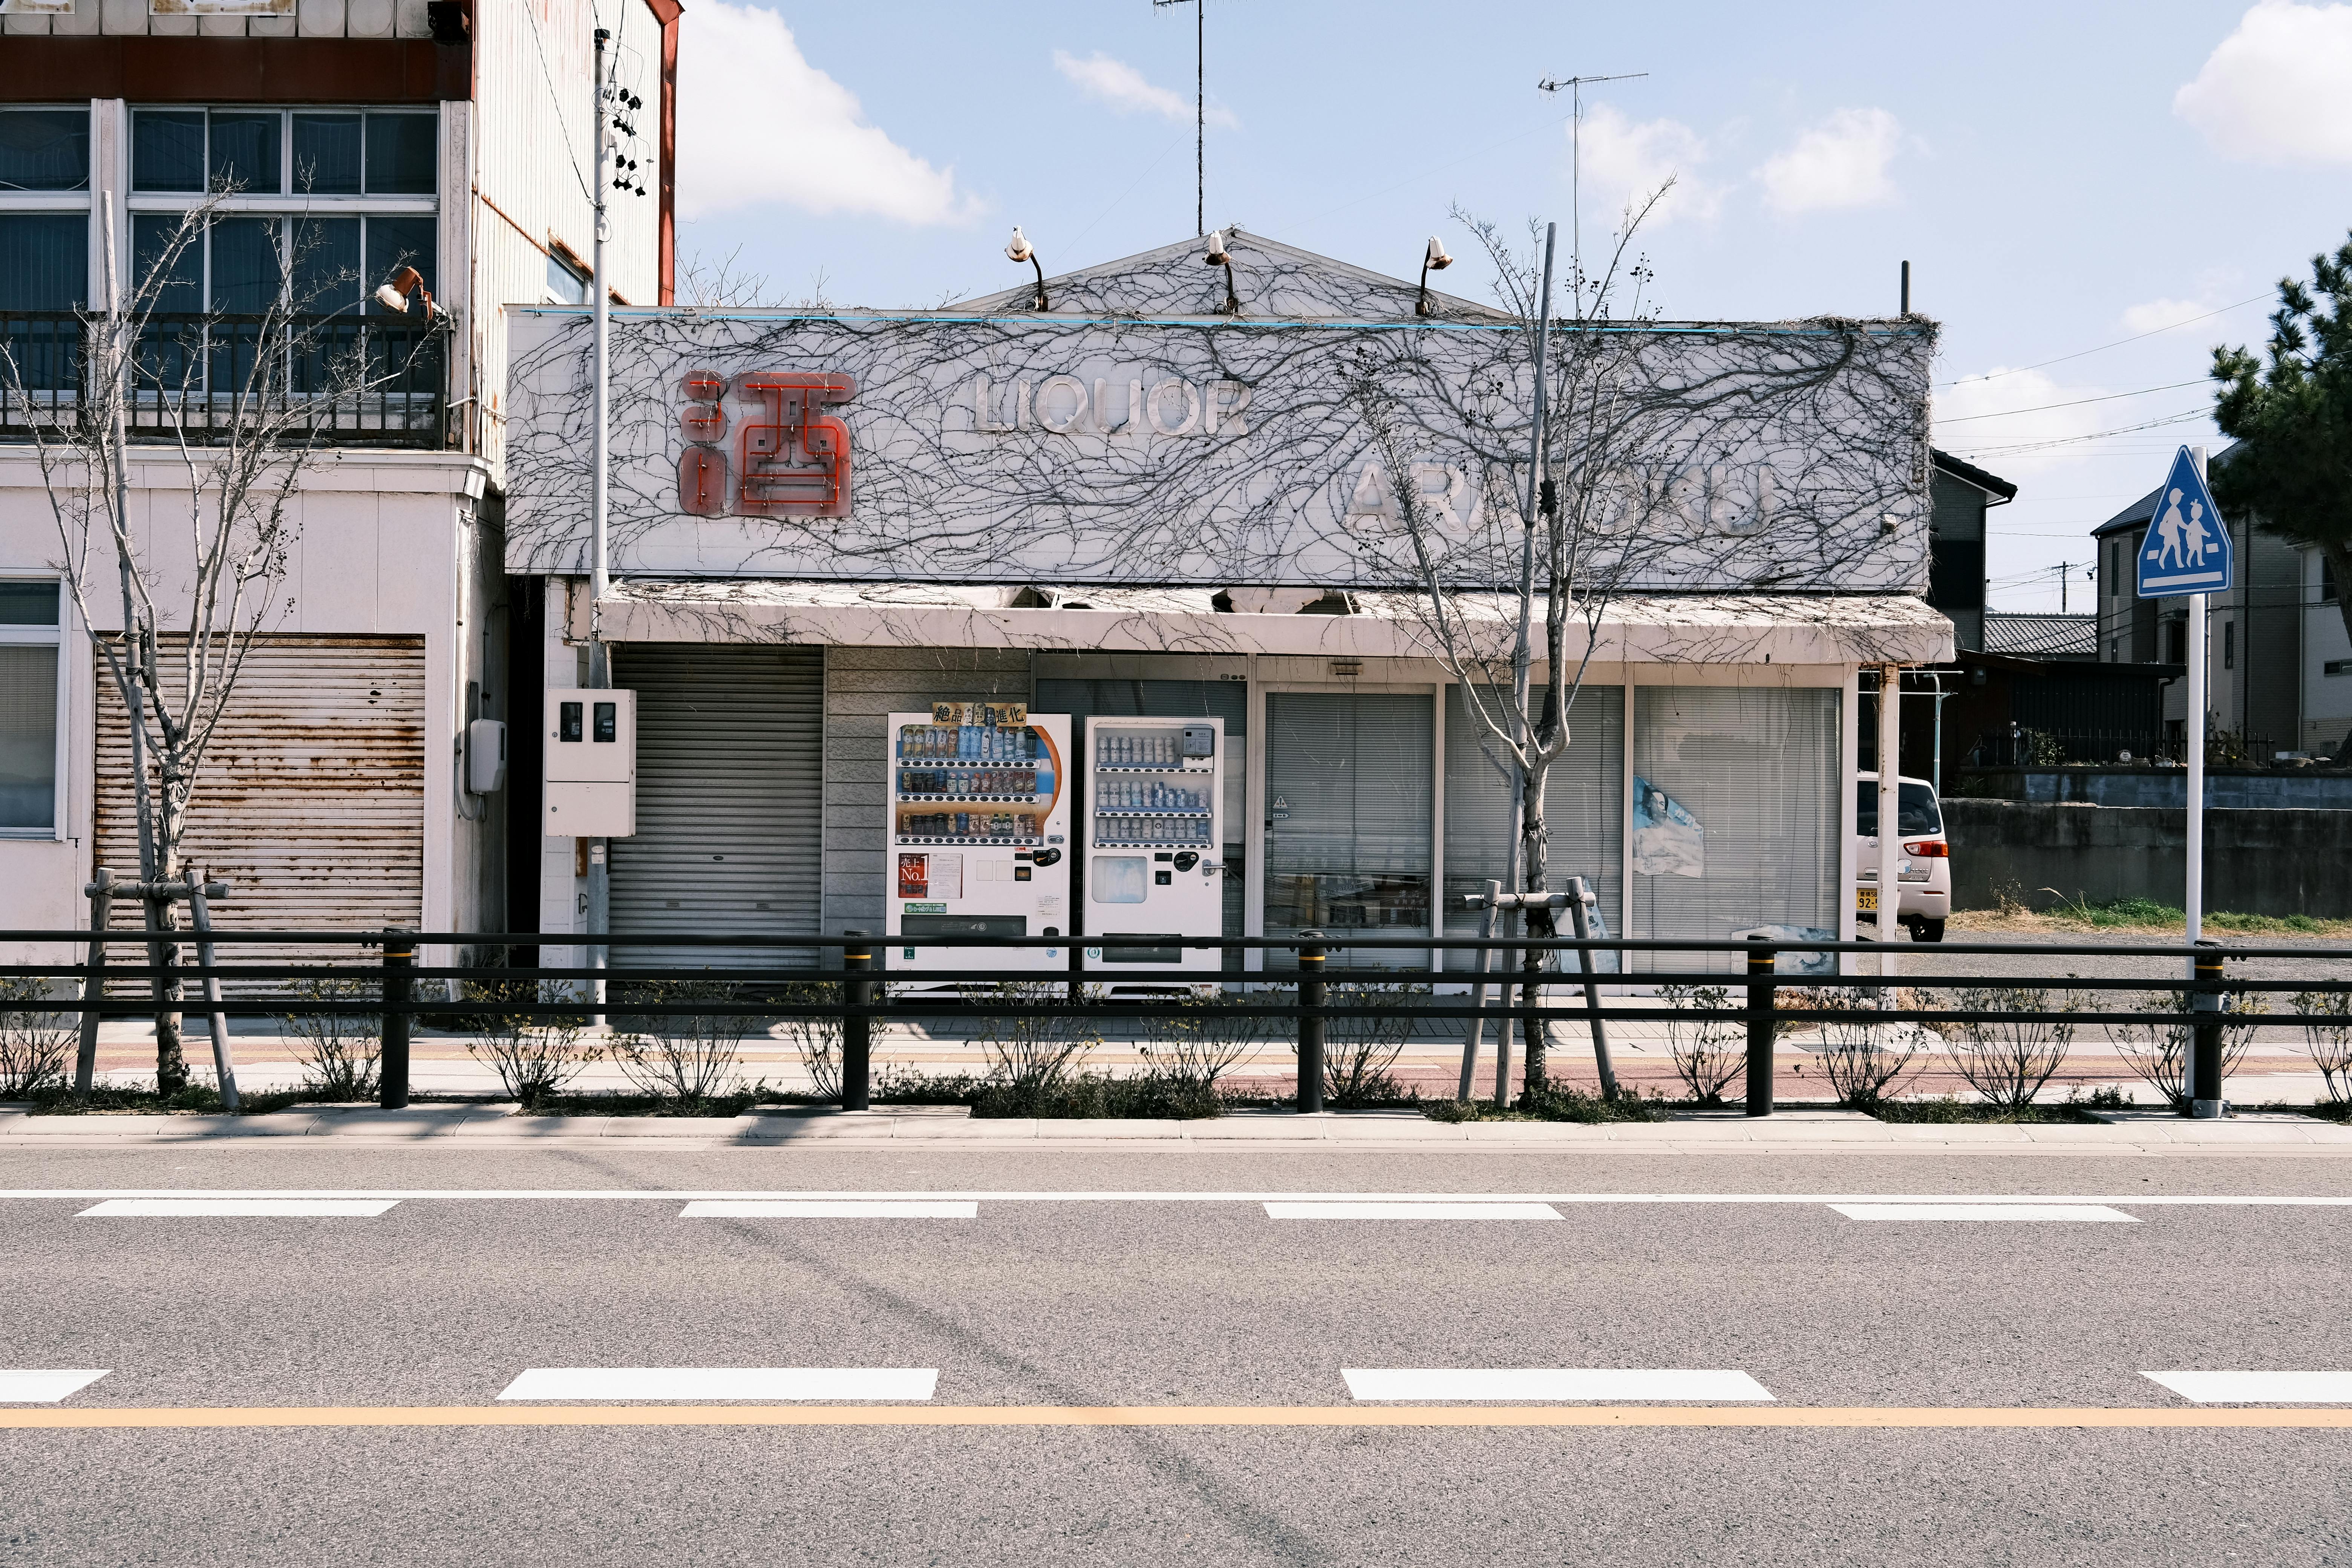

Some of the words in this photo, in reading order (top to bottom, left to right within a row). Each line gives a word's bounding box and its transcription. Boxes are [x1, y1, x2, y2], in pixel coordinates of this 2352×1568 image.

[974, 374, 1253, 436] LIQUOR
[679, 369, 856, 517] 酒
[933, 705, 962, 723] 絶品
[996, 706, 1024, 723] 進化
[901, 858, 920, 868] 売上
